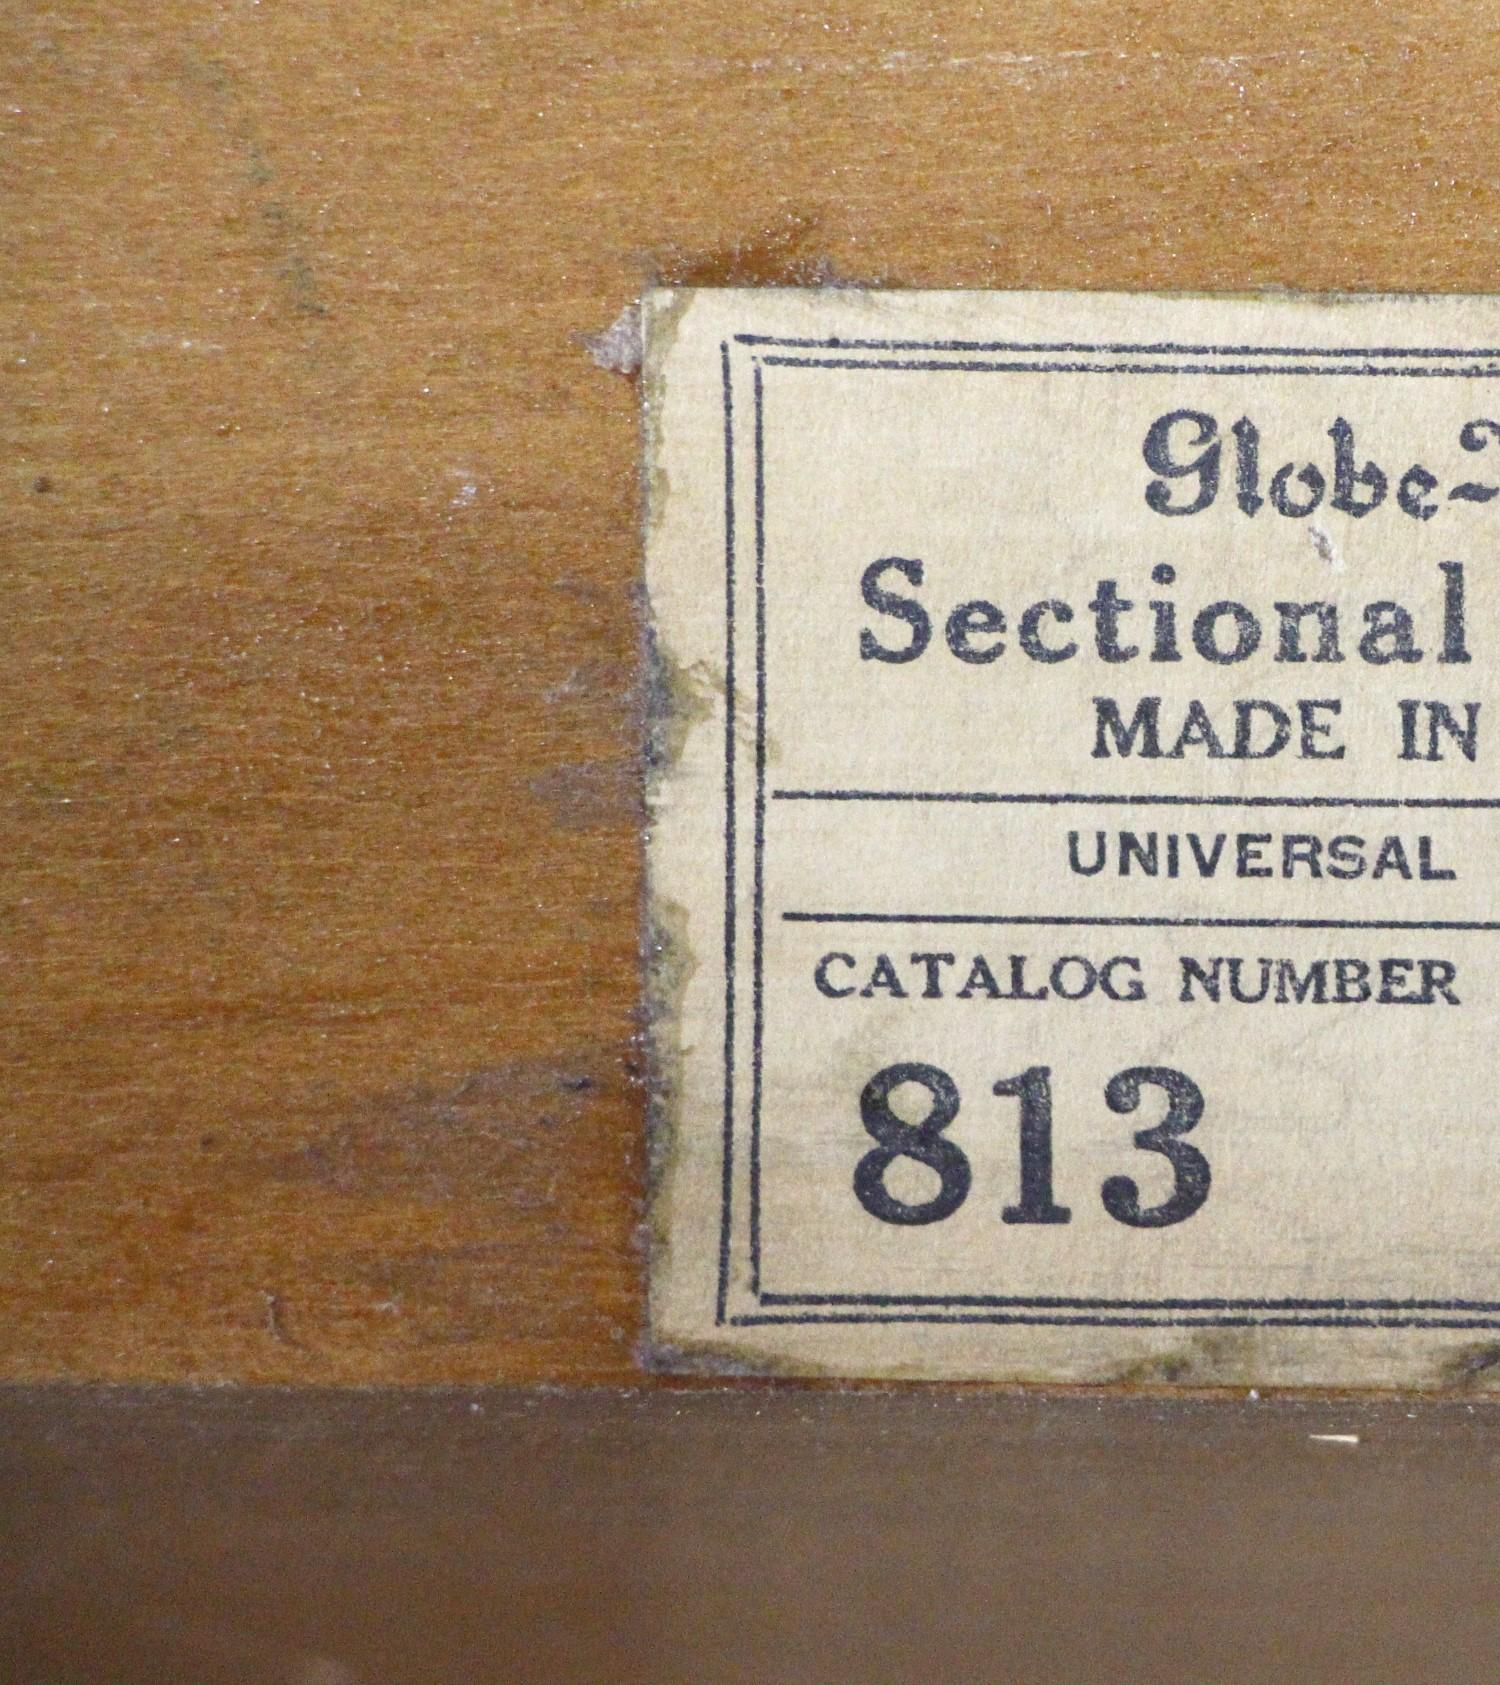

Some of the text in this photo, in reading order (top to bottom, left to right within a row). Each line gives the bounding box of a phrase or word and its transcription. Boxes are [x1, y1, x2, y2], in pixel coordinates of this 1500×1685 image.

[859, 556, 1473, 667] Sectional
[1092, 697, 1346, 760] MADE
[1397, 699, 1481, 762] IN
[1068, 831, 1458, 882] UNIVERSAL
[814, 952, 1462, 1006] CATALOG NUMBER
[852, 1062, 1213, 1230] 813
